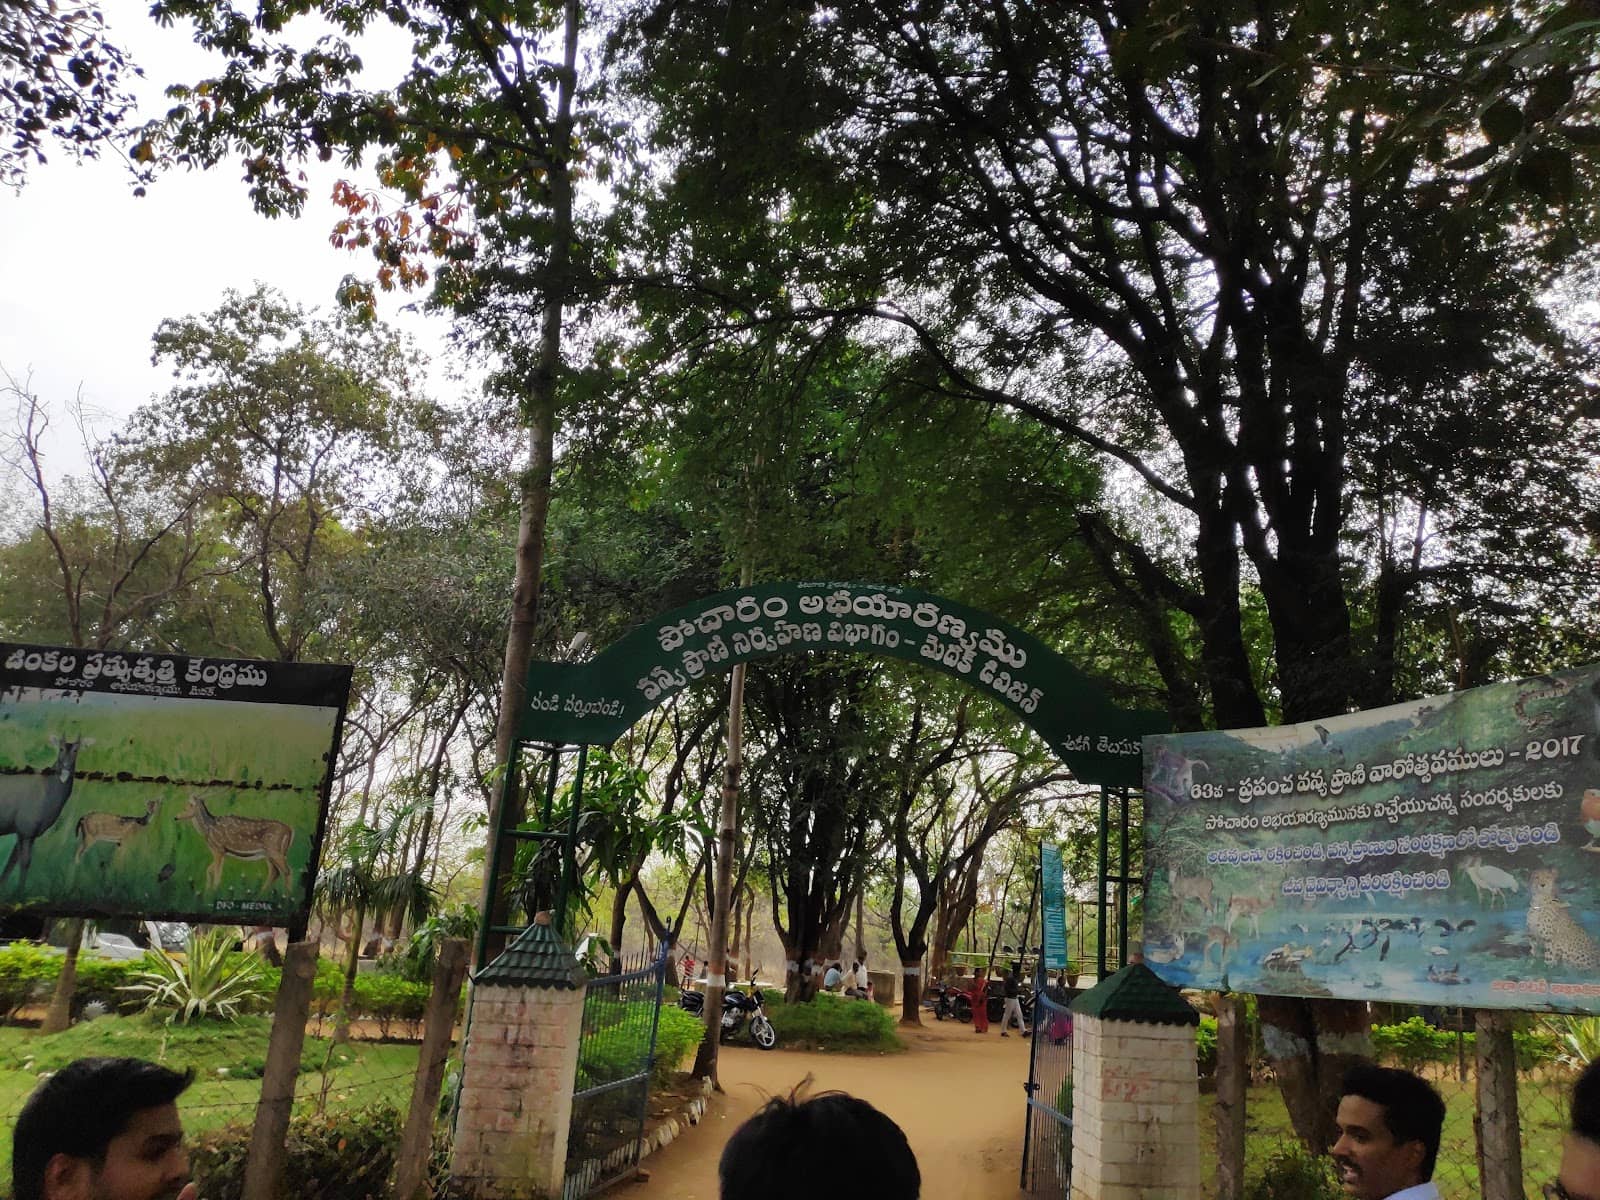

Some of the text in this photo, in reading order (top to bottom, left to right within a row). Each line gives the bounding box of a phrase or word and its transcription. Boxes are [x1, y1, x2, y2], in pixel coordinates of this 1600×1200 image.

[657, 590, 1027, 669] పోచారం అభయారణ్యము
[185, 658, 268, 689] కేంద్రము
[636, 664, 687, 701] వన్య
[682, 634, 730, 680] ప్రాణి
[733, 620, 822, 656] నిర్వహణ
[827, 621, 900, 648] విభాగం
[920, 633, 979, 674] మెదక్
[979, 662, 1044, 714] డివిజన్
[531, 691, 560, 711] రండి
[1238, 773, 1294, 803] ప్రపంచ
[1296, 769, 1328, 798] వన్య
[1330, 762, 1366, 794] ప్రాణి
[1368, 747, 1505, 783] వారోత్సవములు
[1525, 735, 1585, 761] 2017
[1205, 815, 1259, 830] పోచారం
[1261, 804, 1371, 830] అభయారణ్యమునకు
[1460, 781, 1564, 812] సందర్శకులకు
[1207, 848, 1264, 867] అడవులను
